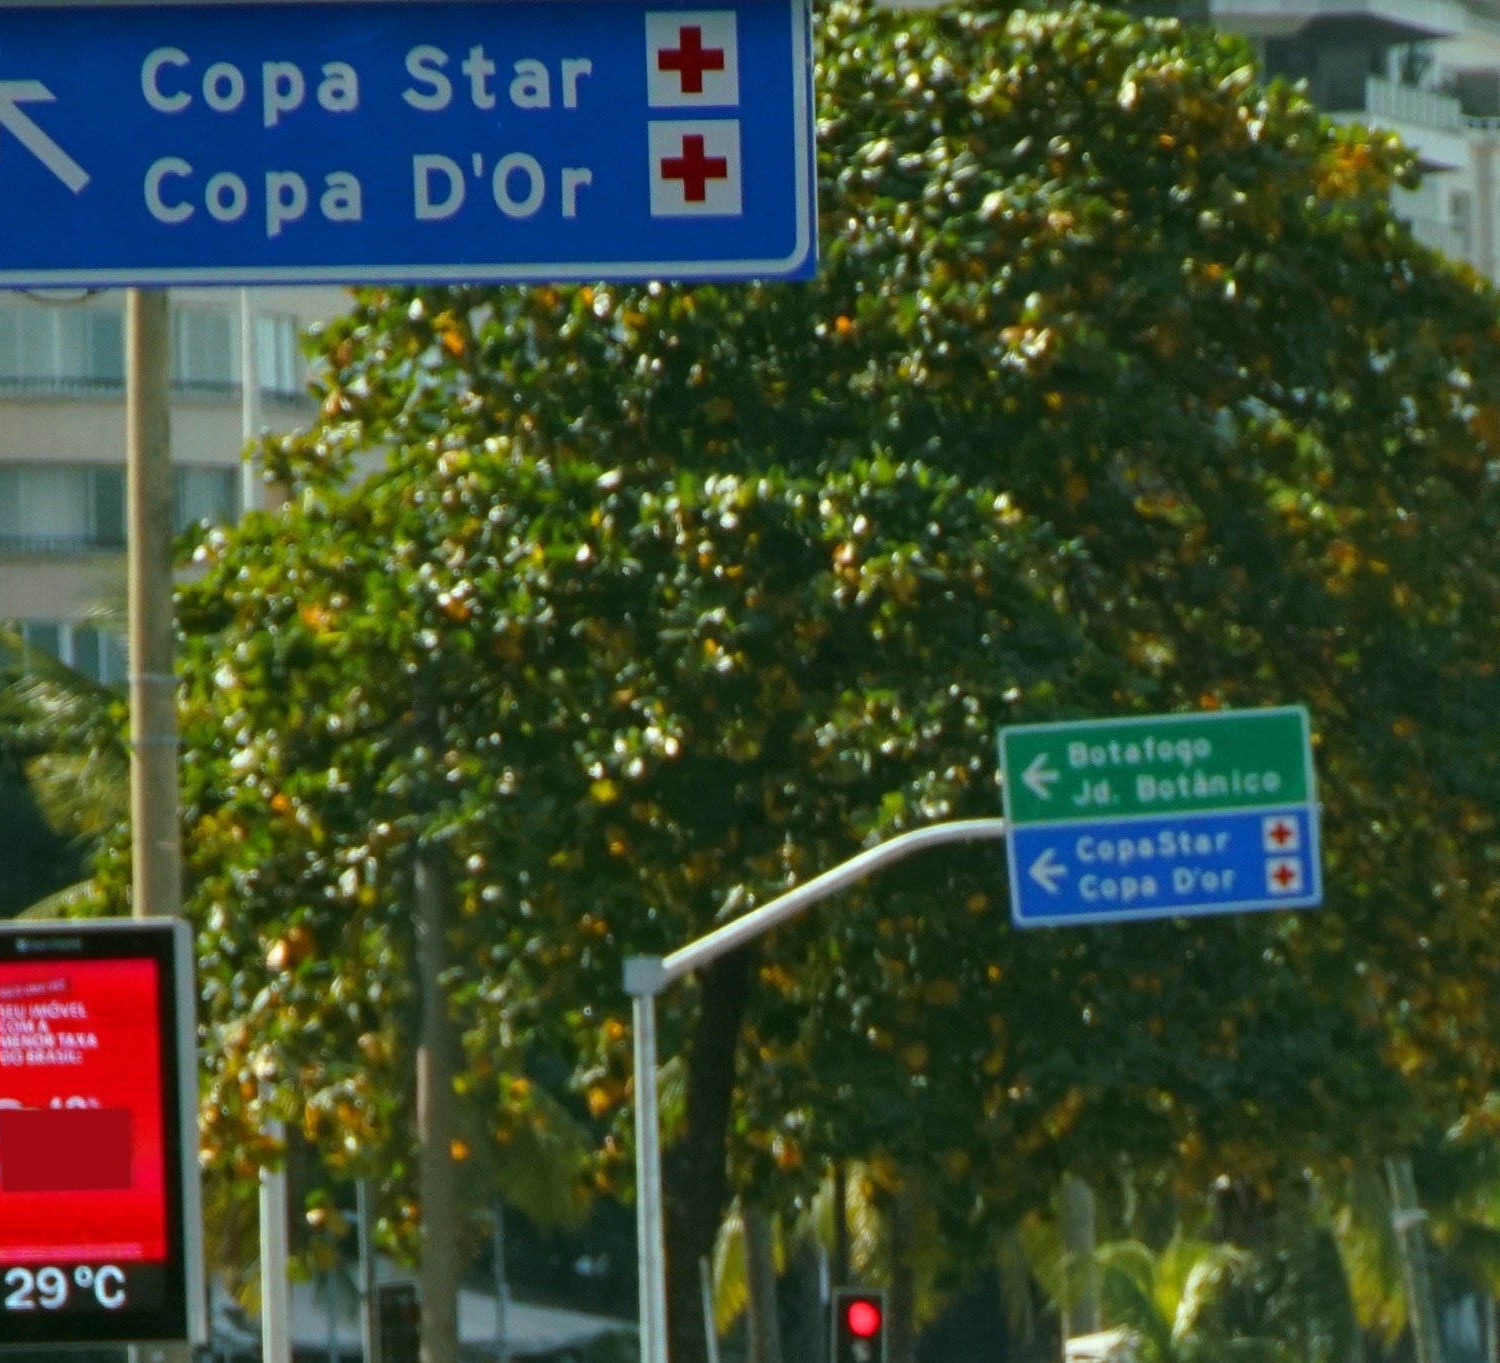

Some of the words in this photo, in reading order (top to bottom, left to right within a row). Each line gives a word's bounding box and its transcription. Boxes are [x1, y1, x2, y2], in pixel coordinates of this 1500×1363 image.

[141, 46, 359, 128] Copa
[403, 45, 593, 114] Star
[143, 157, 363, 239] Copa
[414, 153, 593, 220] D'Or
[1067, 736, 1211, 768] Botafogo
[1136, 769, 1281, 803] Botânico
[1078, 873, 1157, 903] Copa
[29, 999, 87, 1019] IMÓVEL
[0, 1033, 55, 1048] MENOR
[57, 1032, 99, 1049] TAXA
[37, 1018, 49, 1033] A
[0, 1048, 25, 1066] DO
